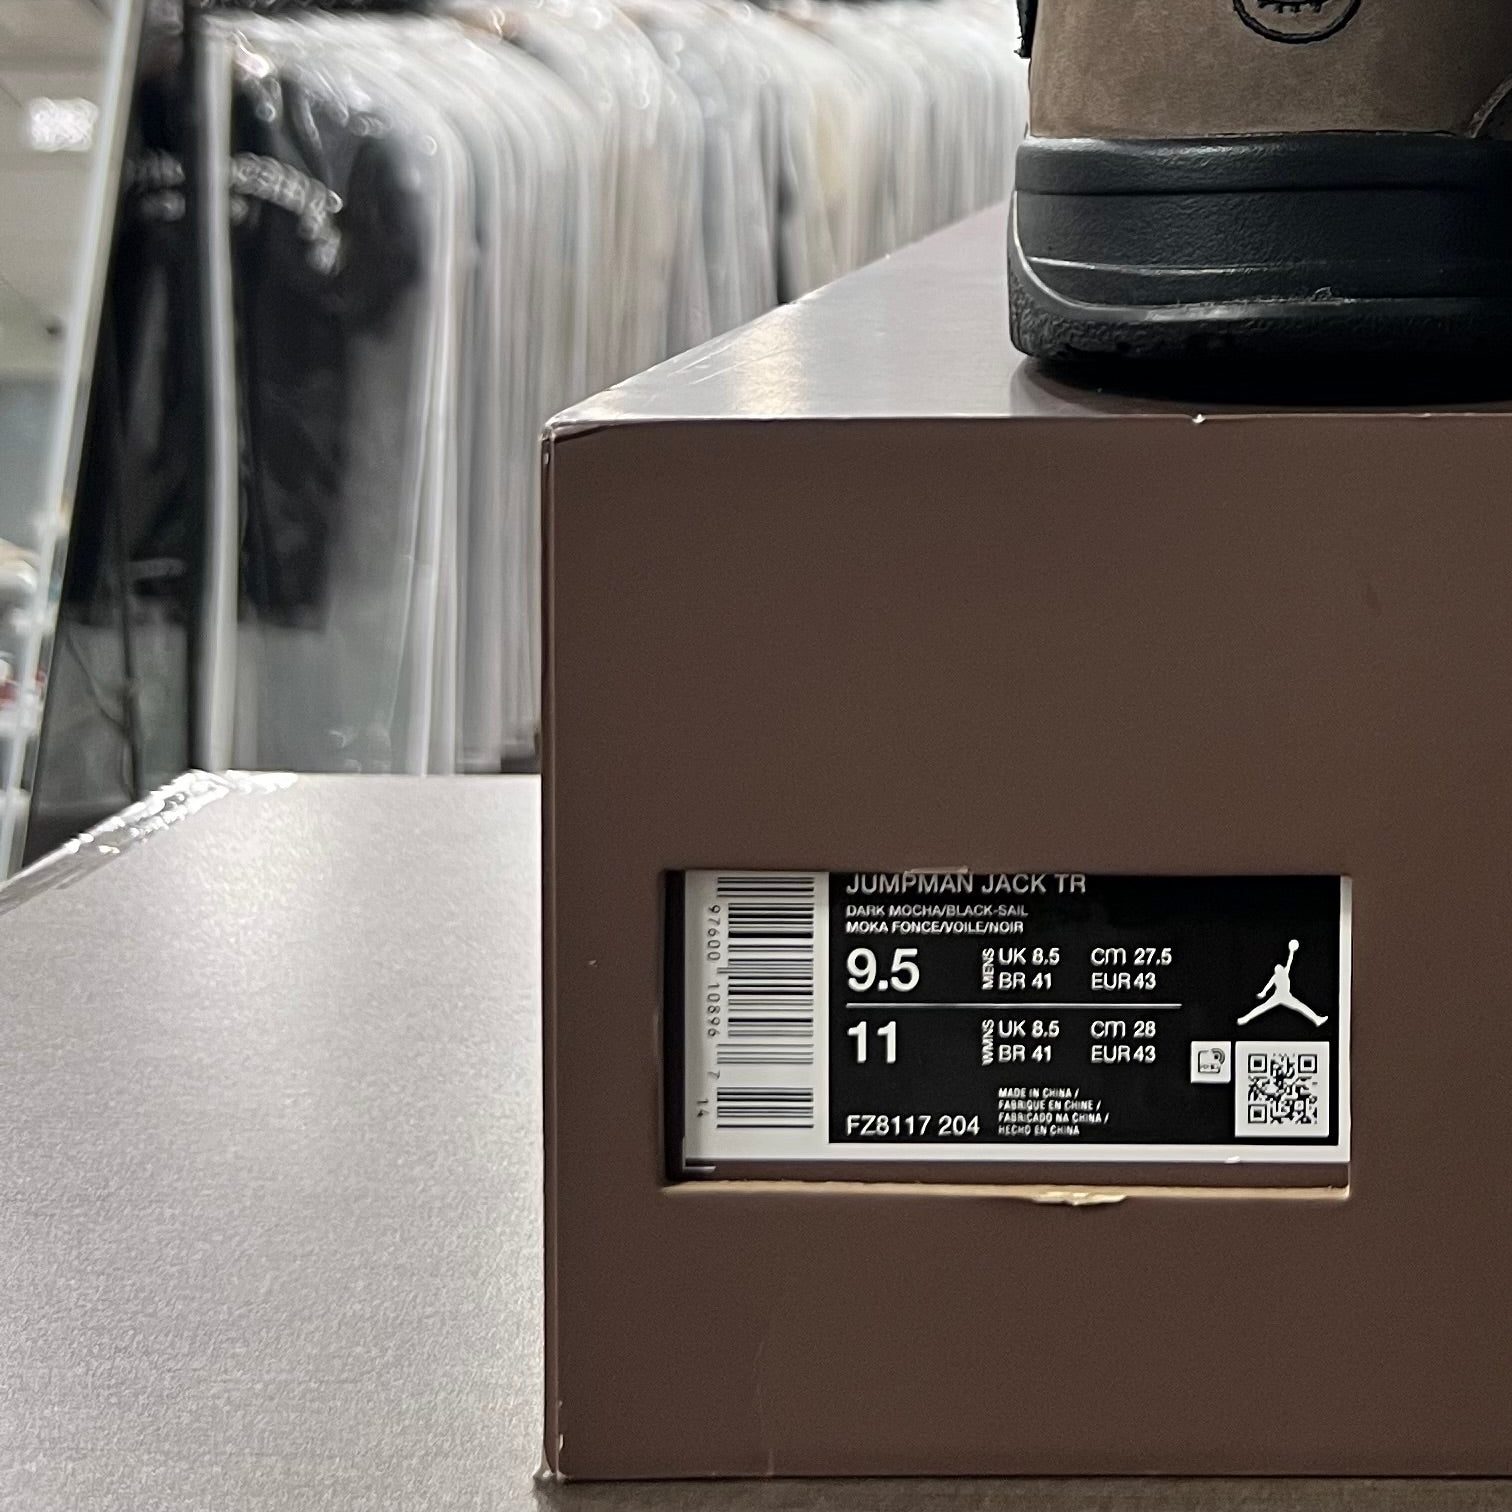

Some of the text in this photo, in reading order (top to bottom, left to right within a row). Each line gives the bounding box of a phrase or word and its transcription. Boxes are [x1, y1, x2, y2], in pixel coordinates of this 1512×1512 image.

[846, 873, 1086, 894] JUMPMAN JACK TR
[845, 904, 1029, 918] DARK MOCHA/BLACK-SAIL
[707, 904, 721, 961] 97600
[845, 920, 1024, 934] MOKA FONCE/VOILE/NOIR
[998, 947, 1060, 966] UK 8.5
[1133, 947, 1173, 966] 27.5
[846, 947, 920, 992] 9.5
[981, 947, 995, 990] MENS
[998, 972, 1052, 990] BR 41
[1091, 972, 1157, 990] EUR 43
[707, 983, 721, 1037] 10896
[998, 1019, 1060, 1038] UK 8.5
[1133, 1020, 1157, 1038] 28
[847, 1020, 897, 1064] 11
[981, 1019, 995, 1066] WMNS
[998, 1044, 1052, 1063] BR 41
[1091, 1044, 1156, 1063] EUR 43
[707, 1070, 721, 1080] 7
[998, 1087, 1027, 1099] MADE
[1028, 1087, 1040, 1098] IN
[1042, 1087, 1073, 1099] CHINA
[998, 1099, 1046, 1111] FABRIQUE
[1048, 1099, 1062, 1111] EN
[1063, 1099, 1094, 1111] CHINE
[846, 1114, 980, 1136] FZ8117 204
[998, 1112, 1053, 1124] FABRICADO
[1055, 1112, 1070, 1123] NA
[1071, 1112, 1102, 1124] CHINA
[998, 1124, 1080, 1136] HECHO EN CHINA
